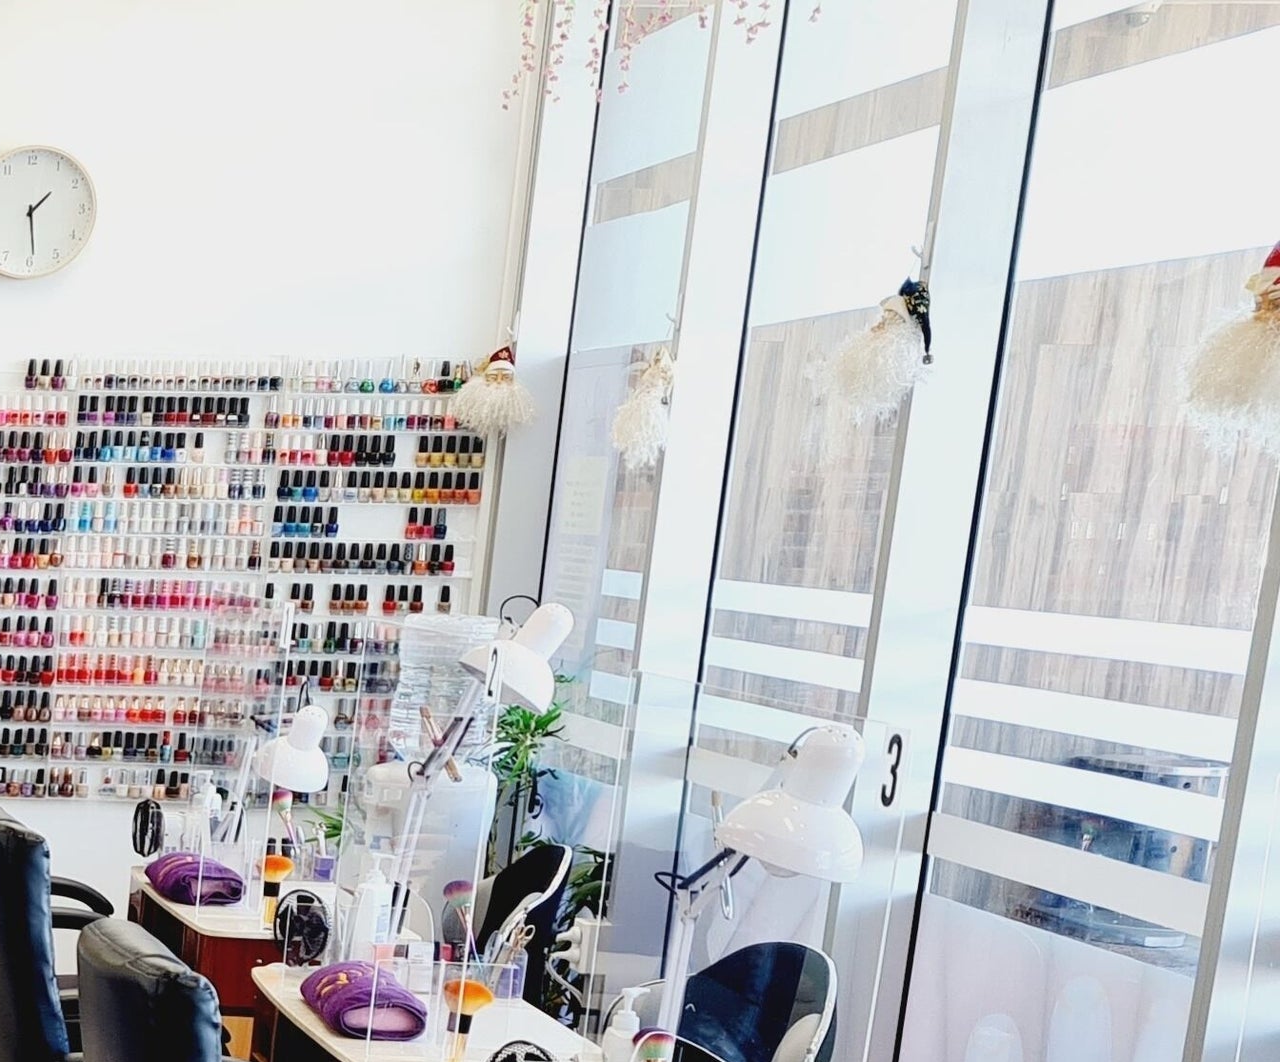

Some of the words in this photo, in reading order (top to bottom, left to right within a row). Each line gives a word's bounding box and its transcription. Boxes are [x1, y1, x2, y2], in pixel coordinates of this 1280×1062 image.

[3, 164, 12, 176] 11
[71, 178, 79, 189] 2
[2, 250, 10, 262] 7
[880, 733, 903, 808] 3
